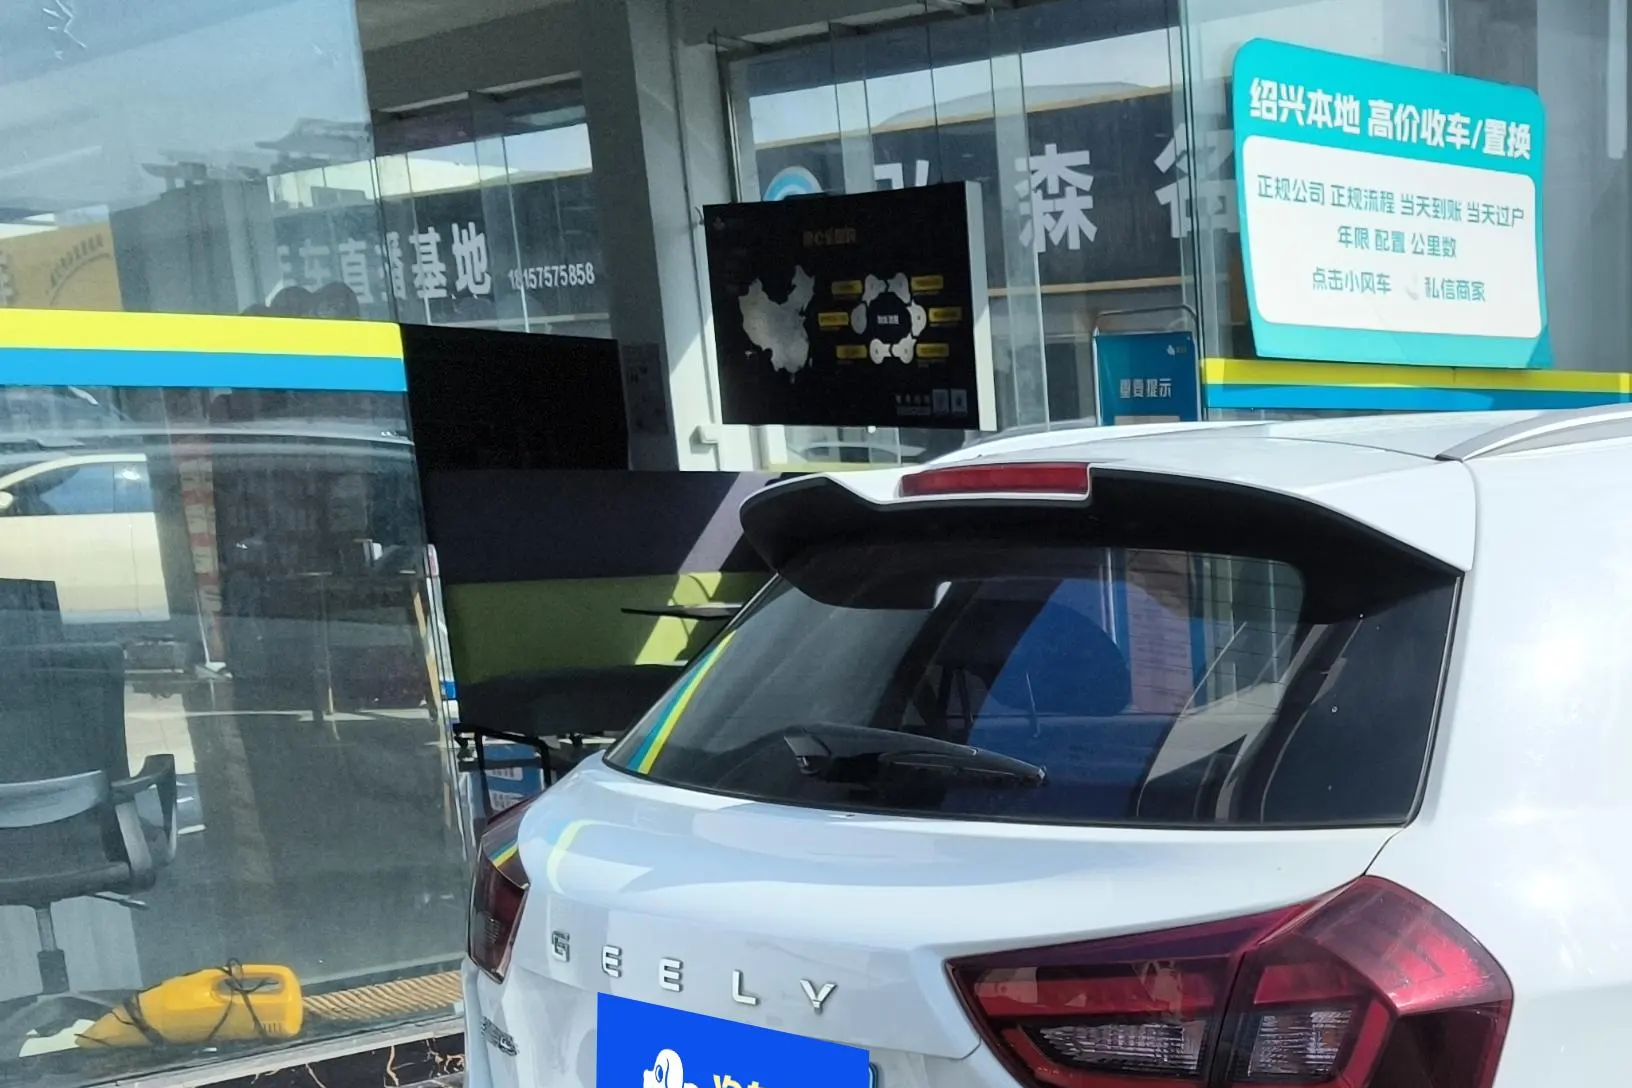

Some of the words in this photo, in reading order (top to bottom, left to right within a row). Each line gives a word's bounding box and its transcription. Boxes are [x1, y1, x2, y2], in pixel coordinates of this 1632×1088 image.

[1250, 78, 1360, 134] 绍兴本地
[1367, 99, 1531, 160] 高价收车/置换
[1257, 175, 1325, 205] 正规公司
[1330, 184, 1395, 214] 正规流程
[1401, 193, 1462, 222] 当天到账
[1467, 202, 1525, 228] 当天过户
[1337, 226, 1370, 250] 年限
[1374, 229, 1406, 254] 配置
[1410, 232, 1458, 258] 公里数
[1312, 267, 1392, 295] 点击小风车
[1424, 276, 1486, 302] 私信商家
[551, 930, 838, 1014] GEELY
